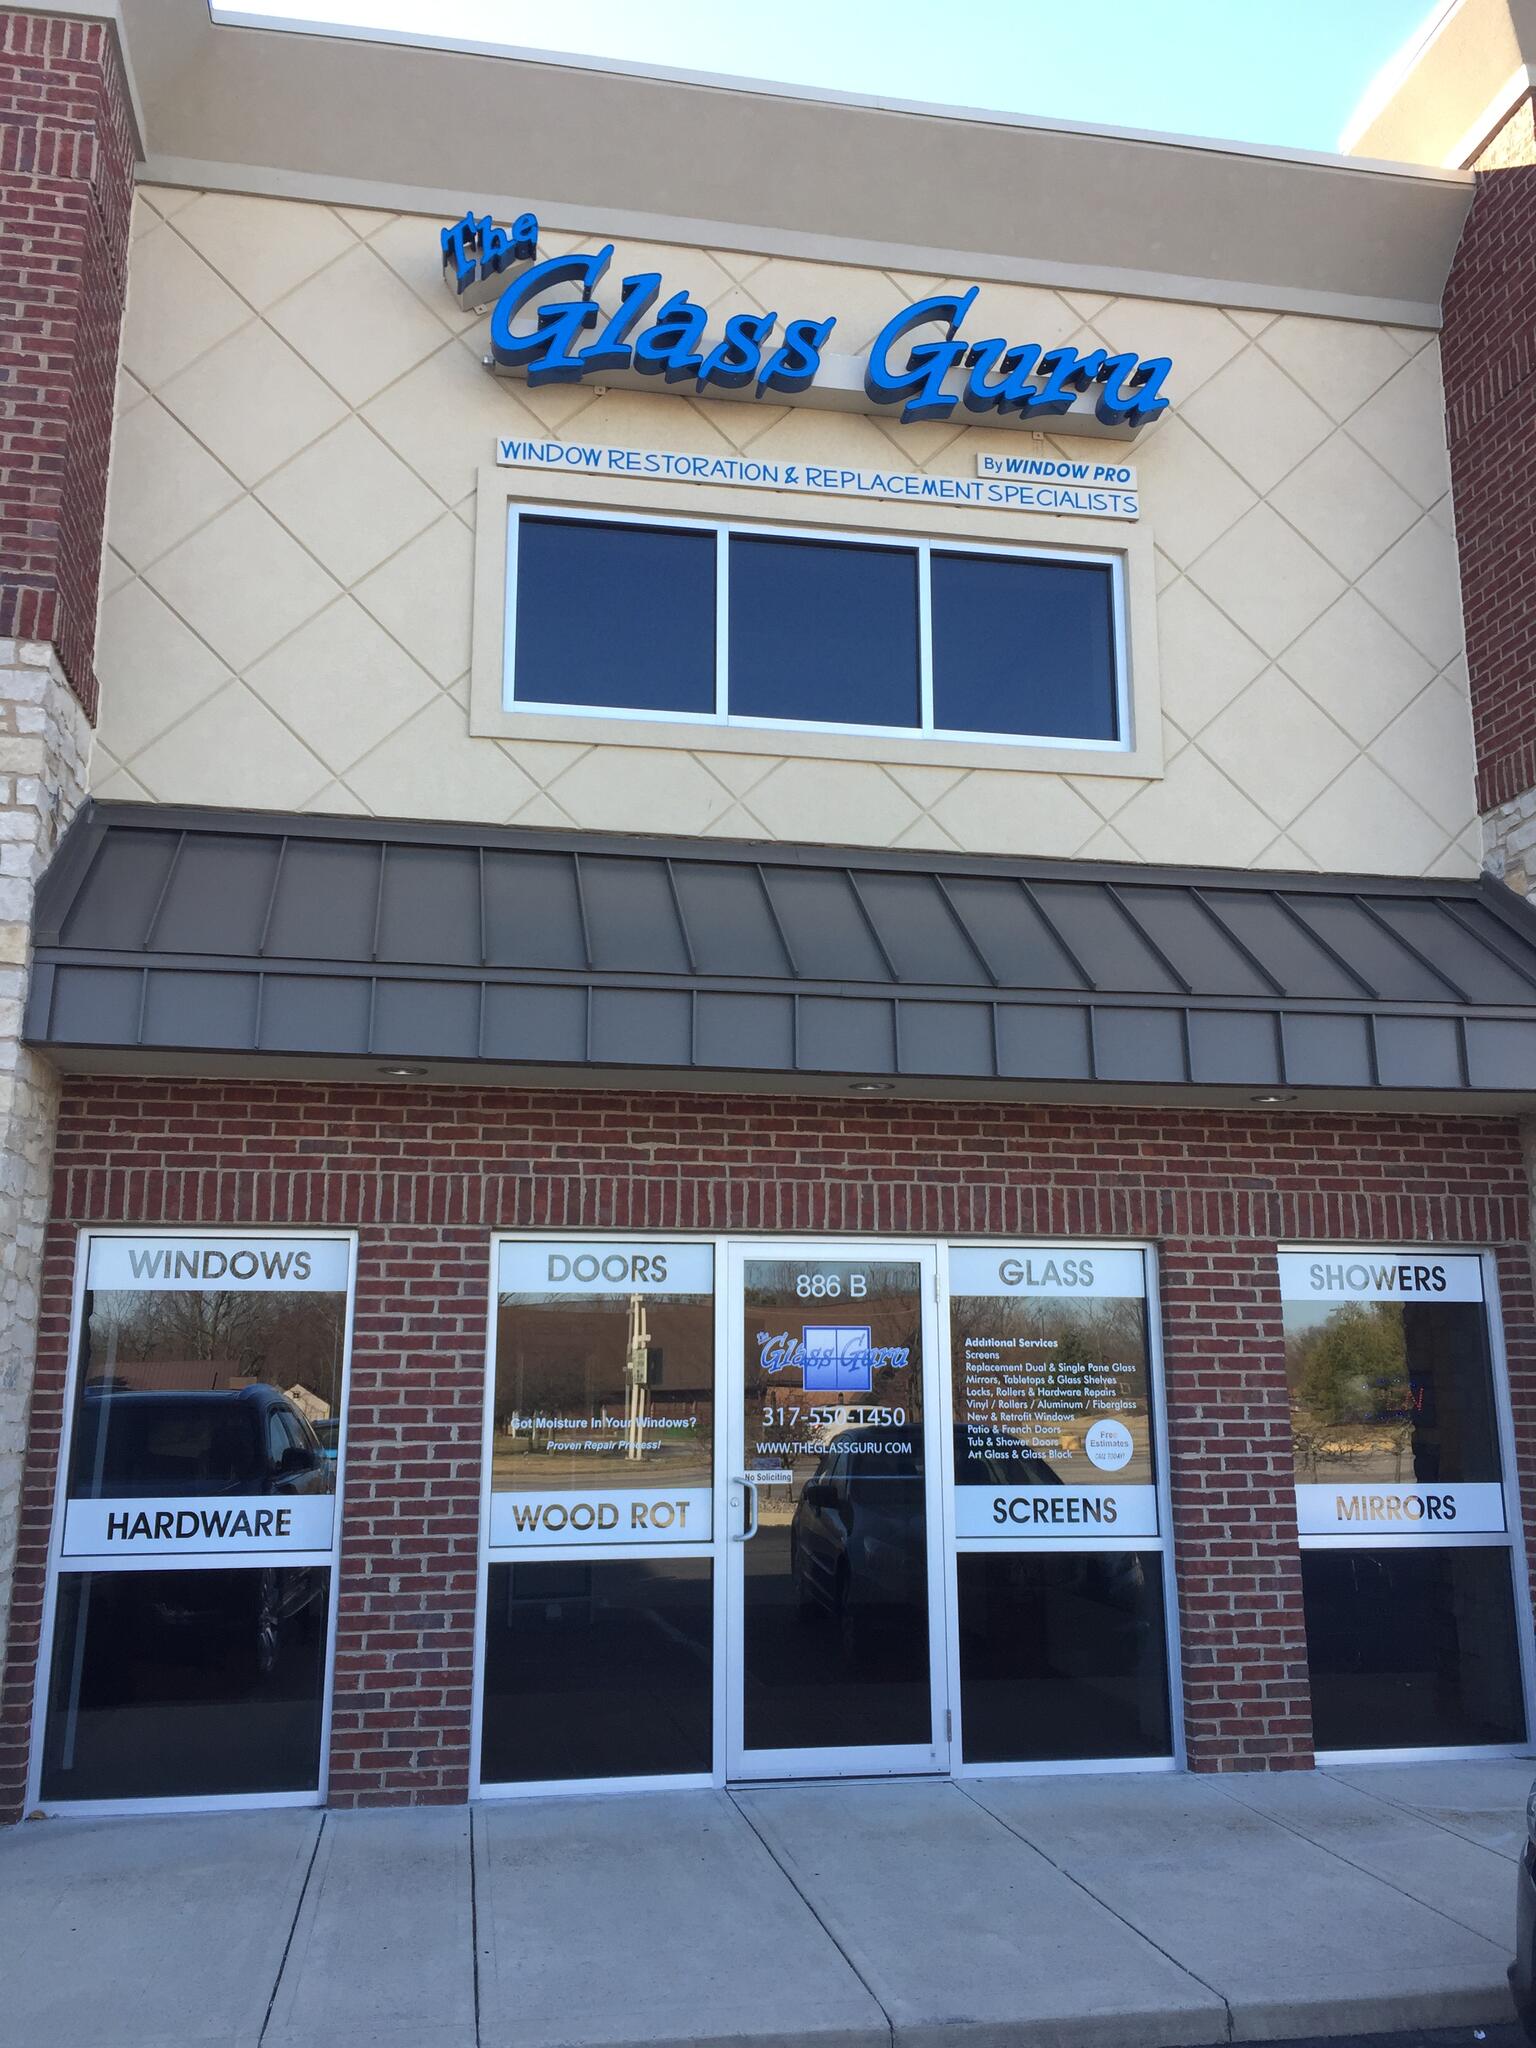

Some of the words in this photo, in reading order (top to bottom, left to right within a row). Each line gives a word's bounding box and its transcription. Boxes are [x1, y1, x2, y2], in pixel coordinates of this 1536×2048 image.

[441, 211, 538, 284] The
[490, 244, 837, 388] Glass
[866, 286, 1172, 420] Guru
[501, 440, 602, 467] WINDOW
[608, 450, 778, 483] RESTORATION
[784, 466, 799, 484] &
[806, 467, 984, 501] REPLACEMENT
[988, 484, 1138, 513] SPECIALISTS
[984, 457, 1003, 474] By
[1006, 458, 1089, 479] WINDOW
[1094, 466, 1130, 483] PRO
[128, 1249, 312, 1280] WINDOWS
[547, 1254, 668, 1283] DOORS
[998, 1258, 1095, 1286] GLASS
[796, 1274, 841, 1297] 886
[850, 1274, 867, 1297] B
[1309, 1263, 1447, 1292] SHOWERS
[760, 1331, 834, 1374] Glass
[841, 1332, 910, 1373] Guru
[965, 1338, 1016, 1348] Additional
[1019, 1338, 1058, 1348] Services
[965, 1350, 1000, 1359] Screens
[966, 1363, 1023, 1373] Replacement
[1025, 1363, 1047, 1372] Dual
[1050, 1363, 1056, 1372] &
[1058, 1363, 1085, 1374] Single
[1088, 1363, 1109, 1372] Pane
[1112, 1363, 1136, 1372] Glass
[966, 1375, 1001, 1385] Mirrors,
[1003, 1375, 1045, 1386] Tabletops
[1048, 1375, 1055, 1384] &
[1057, 1375, 1081, 1384] Glass
[1083, 1375, 1117, 1384] Shelves
[966, 1387, 994, 1397] Locks,
[996, 1387, 1026, 1397] Rollers
[1028, 1387, 1035, 1397] &
[1038, 1387, 1082, 1397] Hardware
[1084, 1387, 1116, 1398] Repairs
[966, 1400, 989, 1411] Vinyl
[991, 1400, 996, 1409] /
[999, 1400, 1028, 1409] Rollers
[1030, 1400, 1035, 1409] /
[1037, 1400, 1083, 1409] Aluminum
[1085, 1400, 1090, 1409] /
[1092, 1400, 1137, 1411] Fiberglass
[511, 1417, 533, 1429] Got
[535, 1417, 588, 1429] Moisture
[591, 1417, 602, 1429] In
[604, 1417, 632, 1429] Your
[635, 1417, 697, 1429] Windows?
[762, 1407, 905, 1426] 317-550-1450
[967, 1412, 989, 1421] New
[990, 1412, 998, 1421] &
[1000, 1412, 1032, 1421] Retrofit
[1034, 1412, 1075, 1421] Windows
[967, 1425, 990, 1434] Patio
[992, 1425, 999, 1434] &
[1002, 1425, 1032, 1434] French
[1034, 1425, 1062, 1434] Doors
[547, 1440, 582, 1450] Proven
[584, 1440, 617, 1452] Repair
[968, 1437, 984, 1446] Tub
[986, 1437, 993, 1446] &
[995, 1437, 1029, 1446] Shower
[1032, 1437, 1059, 1446] Doors
[1090, 1440, 1129, 1448] Estimates
[968, 1450, 982, 1459] Art
[985, 1450, 1009, 1459] Glass
[1011, 1450, 1019, 1459] &
[1021, 1450, 1046, 1459] Glass
[1048, 1450, 1073, 1459] Block
[744, 1473, 755, 1481] No
[757, 1472, 792, 1482] Soliciting
[512, 1502, 619, 1532] WOOD
[631, 1501, 690, 1529] ROT
[993, 1497, 1118, 1524] SCREENS
[1336, 1494, 1457, 1521] MIRRORS
[107, 1508, 291, 1540] HARDWARE
